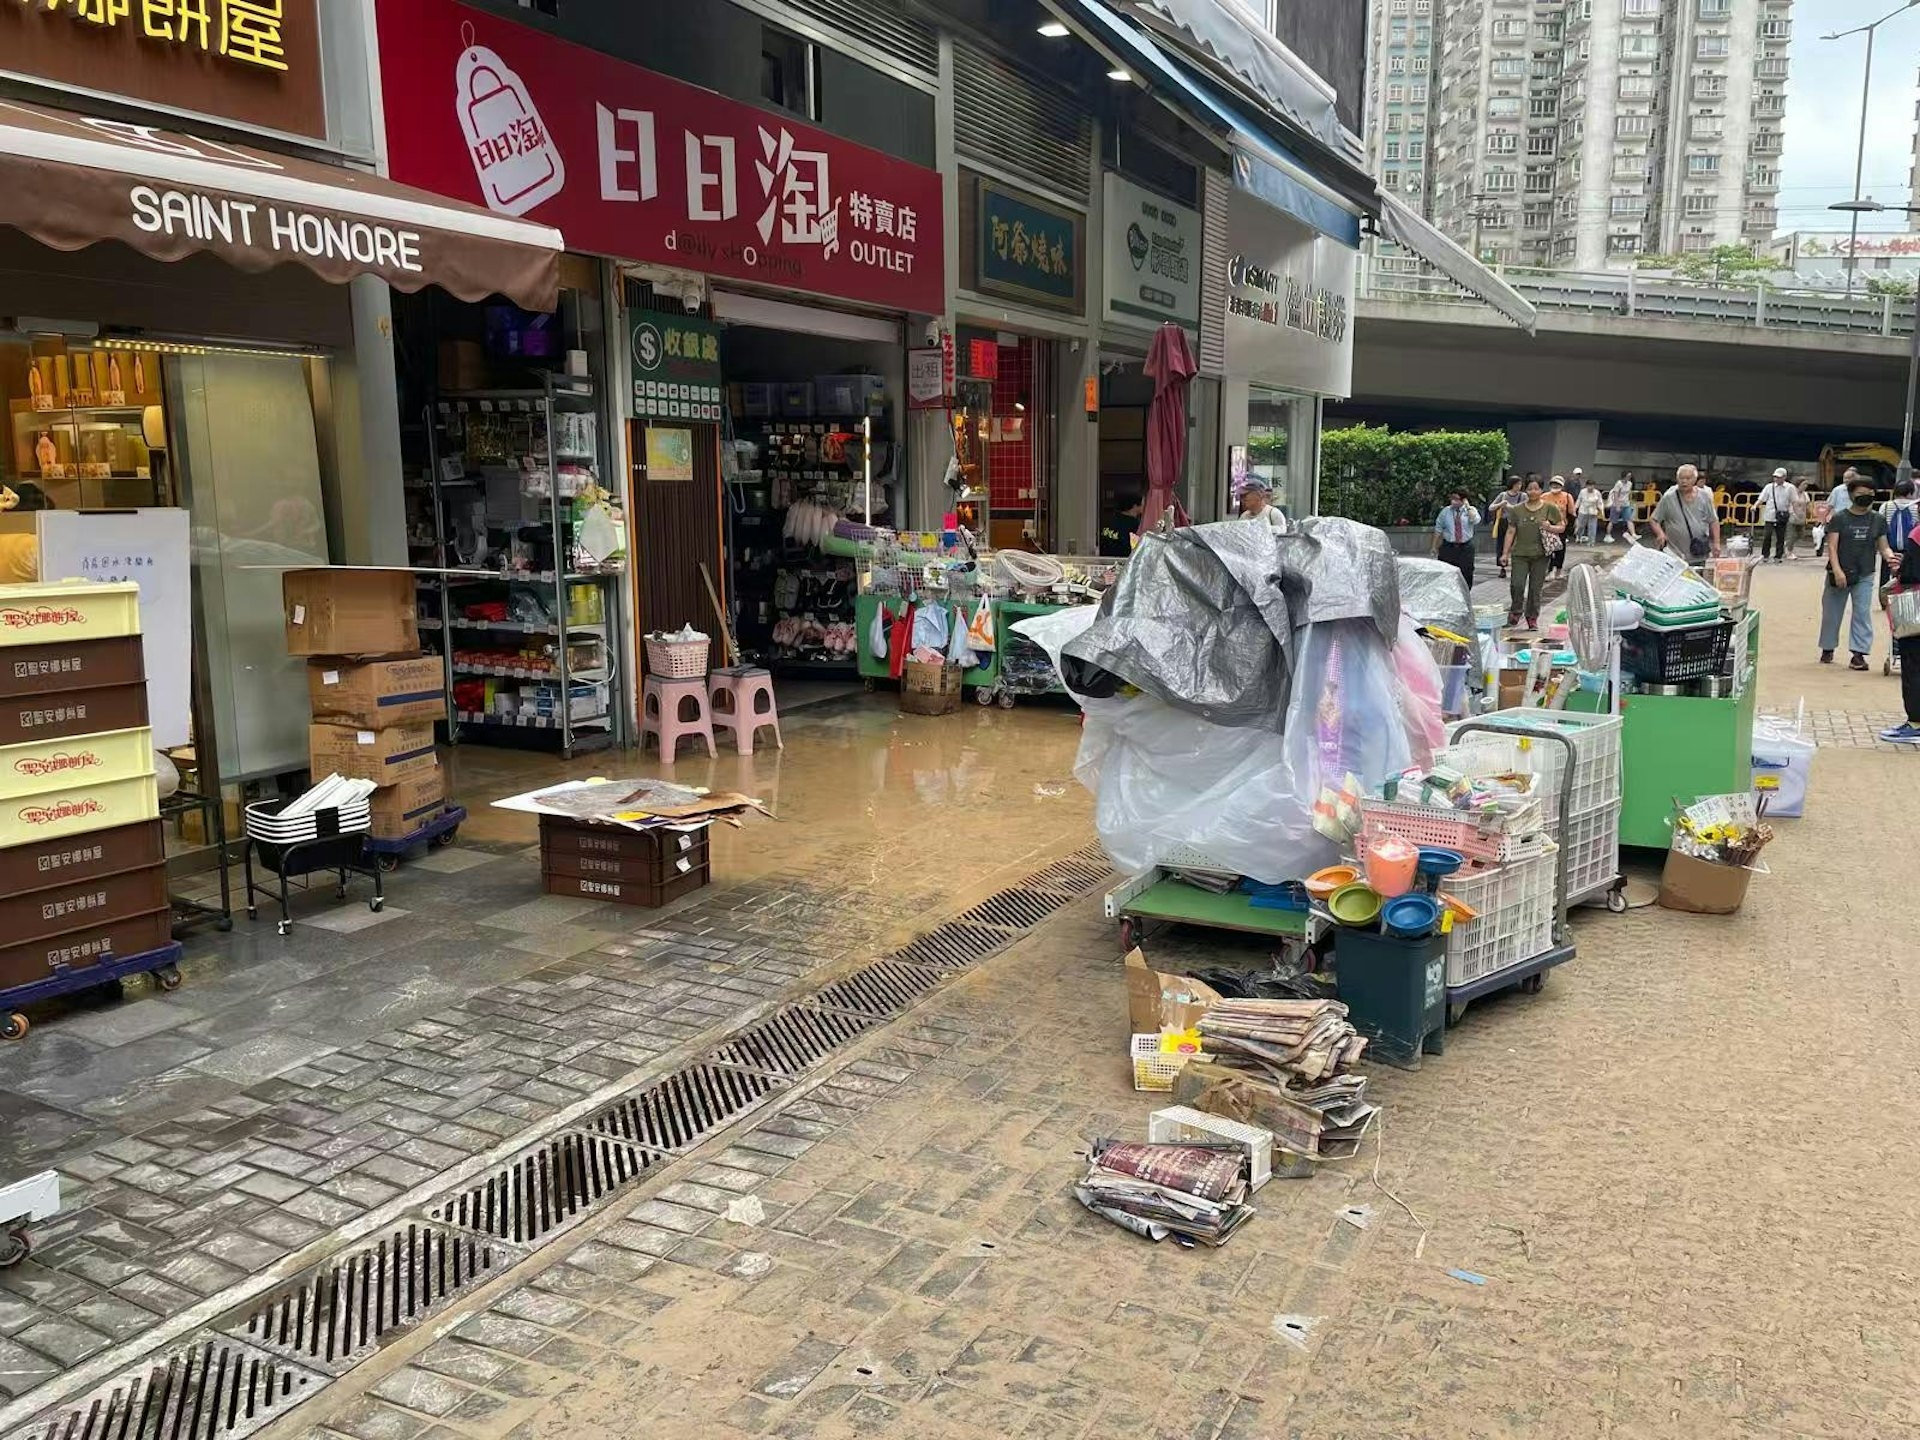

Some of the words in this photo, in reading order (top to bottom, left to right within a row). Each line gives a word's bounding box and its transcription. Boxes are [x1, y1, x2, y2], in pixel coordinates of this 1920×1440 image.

[474, 116, 541, 171] 日日淘
[595, 101, 833, 247] 日日淘
[131, 186, 258, 247] SAINT
[269, 207, 424, 273] HONORE
[849, 190, 918, 243] 特賣店
[849, 240, 915, 274] OUTLET
[911, 362, 940, 379] 出租
